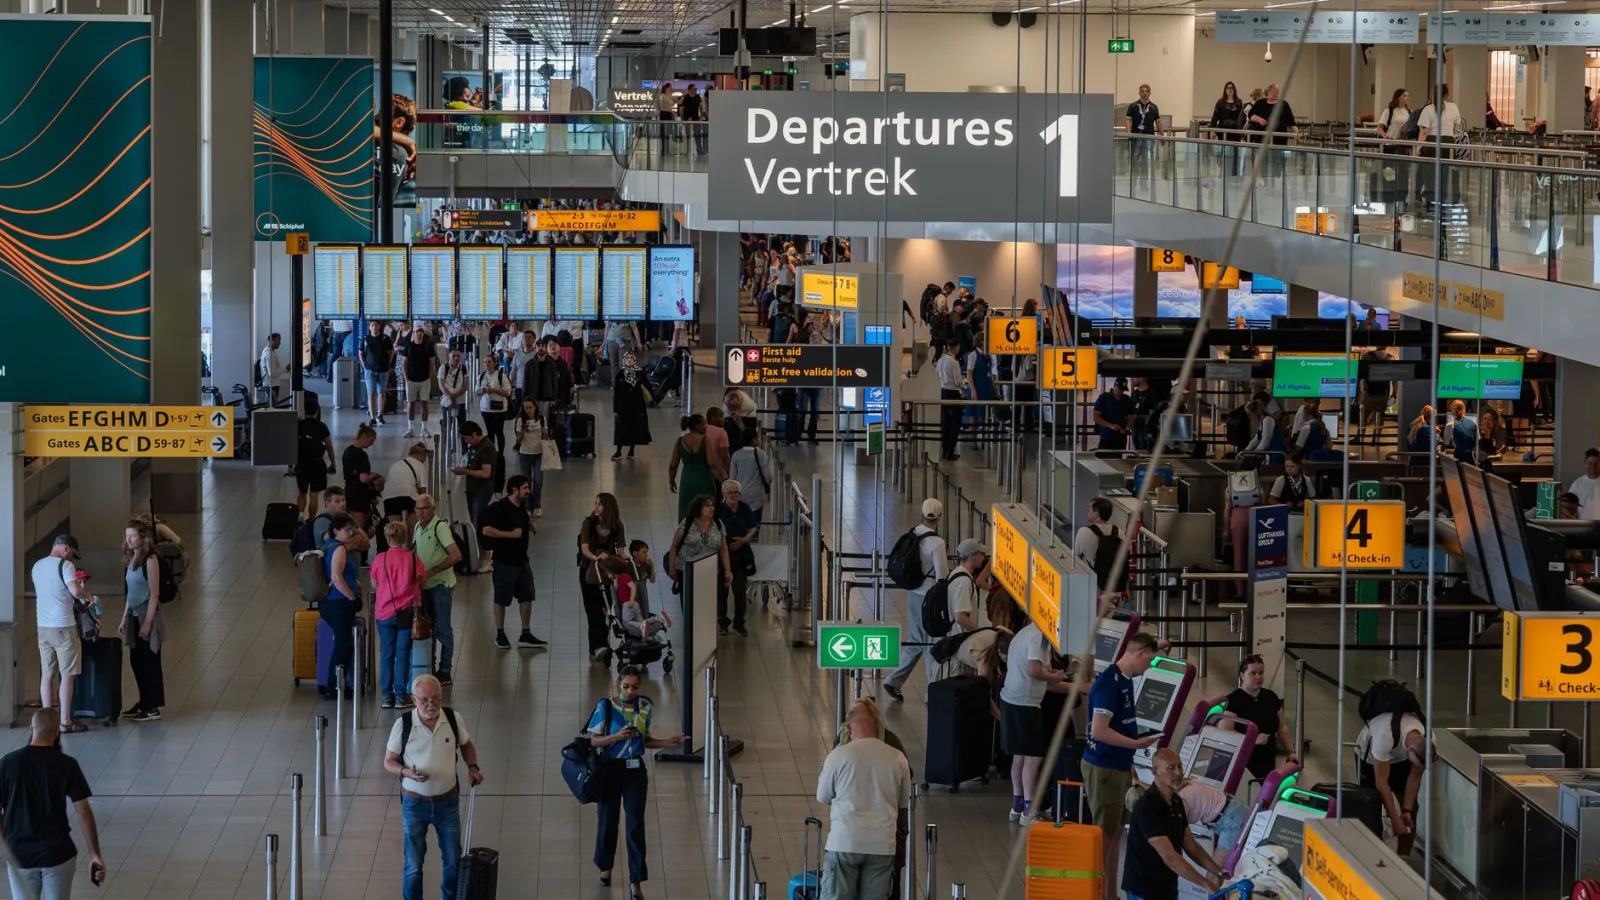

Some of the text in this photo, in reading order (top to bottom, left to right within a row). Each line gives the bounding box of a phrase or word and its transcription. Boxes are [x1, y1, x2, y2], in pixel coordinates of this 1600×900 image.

[614, 91, 653, 101] Vertrek
[456, 124, 470, 132] the
[748, 108, 1014, 154] Departures
[1039, 114, 1078, 198] 1
[744, 157, 918, 196] Vertrek
[1163, 250, 1174, 264] 8
[840, 279, 844, 288] 7
[846, 280, 851, 289] 8
[1005, 320, 1021, 344] 6
[762, 347, 802, 356] First aid
[1062, 352, 1076, 376] 5
[762, 367, 852, 376] Tax free validaion
[32, 414, 65, 423] Gates
[48, 436, 186, 452] Gates ABC D 59-87
[1346, 508, 1372, 548] 4
[1258, 530, 1285, 539] LUFTHANSA
[1258, 538, 1274, 546] GROUP
[1348, 554, 1390, 563] Check-in
[1560, 624, 1592, 674] 3
